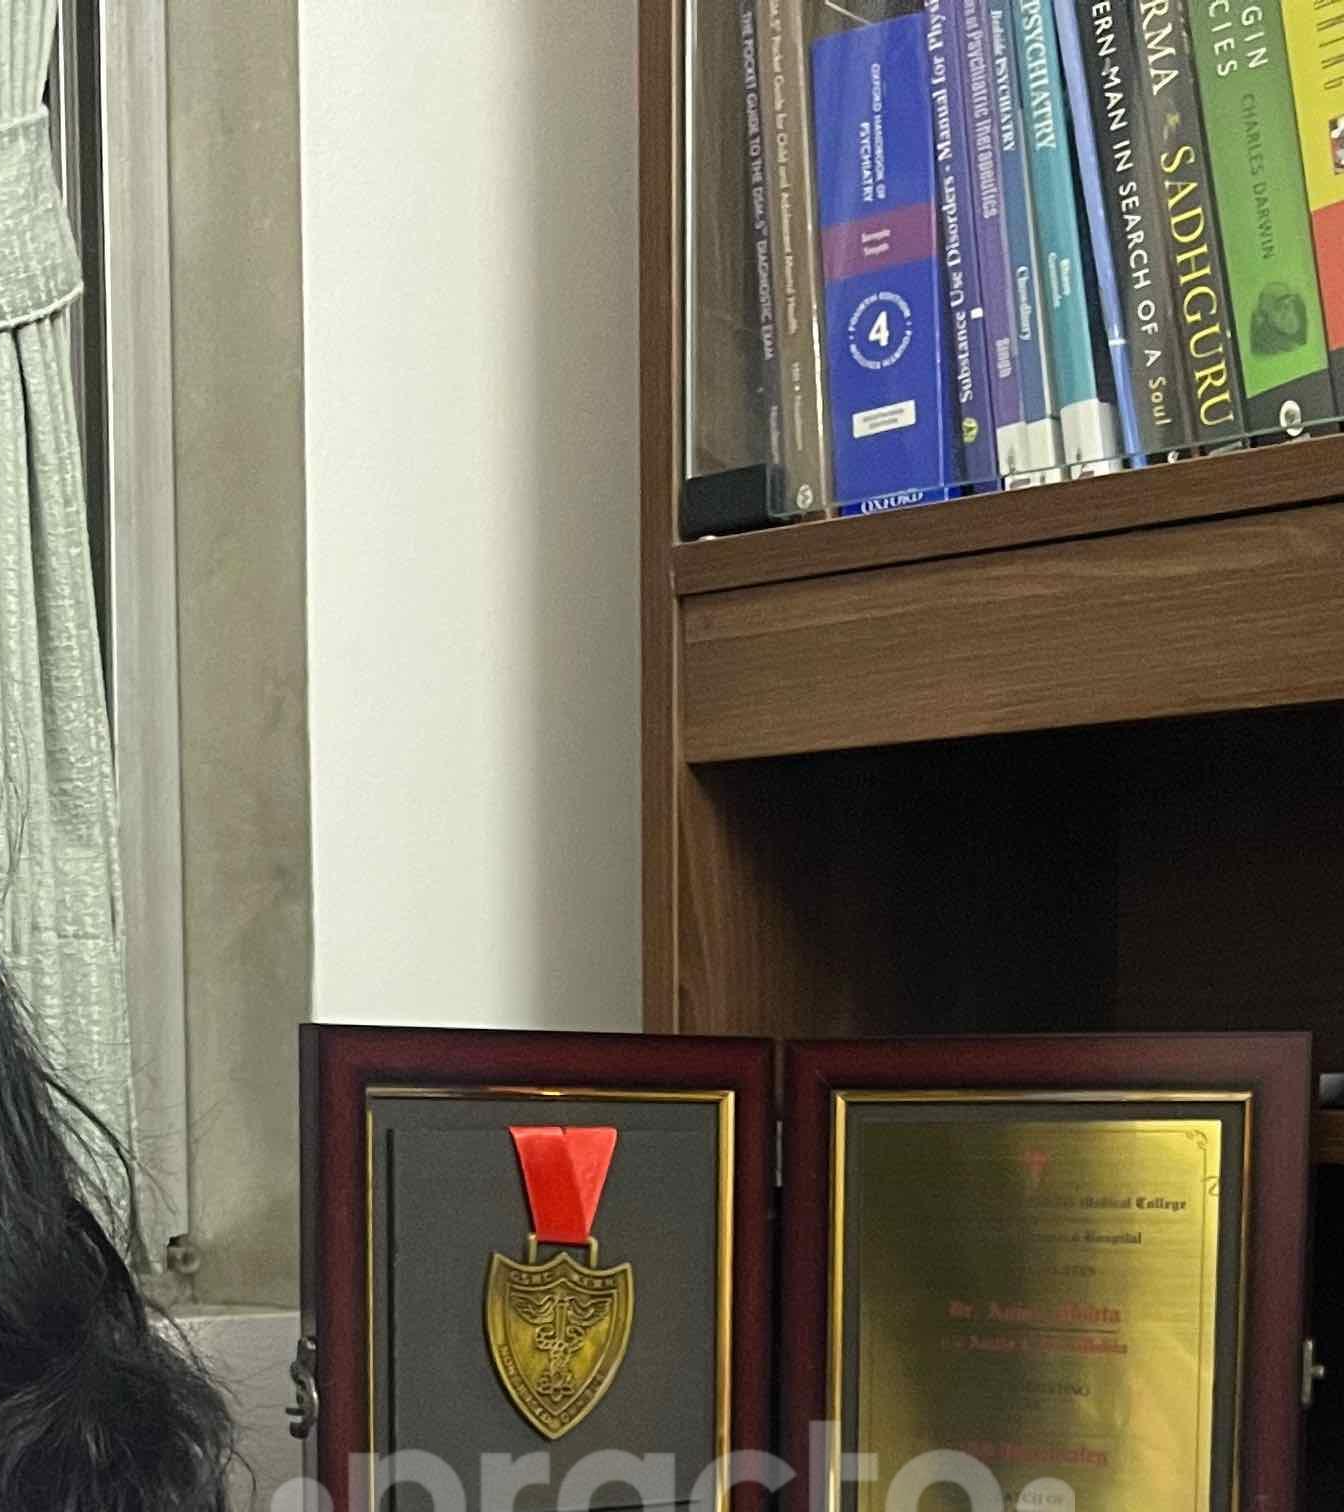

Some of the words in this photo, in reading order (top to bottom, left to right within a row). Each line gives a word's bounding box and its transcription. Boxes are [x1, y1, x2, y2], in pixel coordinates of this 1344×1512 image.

[931, 56, 946, 85] for
[966, 30, 989, 118] Psychiatric
[995, 57, 1015, 151] PSYCHIATRY
[1021, 0, 1057, 150] PSYCHIATRY
[1102, 66, 1128, 131] MAN
[860, 122, 874, 202] PSYCHIATRY
[932, 89, 952, 161] Manual
[1113, 140, 1134, 173] IN
[975, 118, 999, 219] Therapeutics
[1242, 94, 1264, 176] CHARLES
[1254, 183, 1275, 259] DARWIN
[942, 176, 961, 267] Disorders
[1119, 181, 1152, 289] SEARCH
[950, 271, 964, 307] Use
[1137, 300, 1159, 336] OF
[1160, 145, 1234, 426] SADHGURU
[869, 311, 890, 346] 4
[953, 311, 973, 404] Substance
[1144, 349, 1162, 367] A
[1148, 376, 1172, 425] Soul
[1135, 1196, 1187, 1213] College
